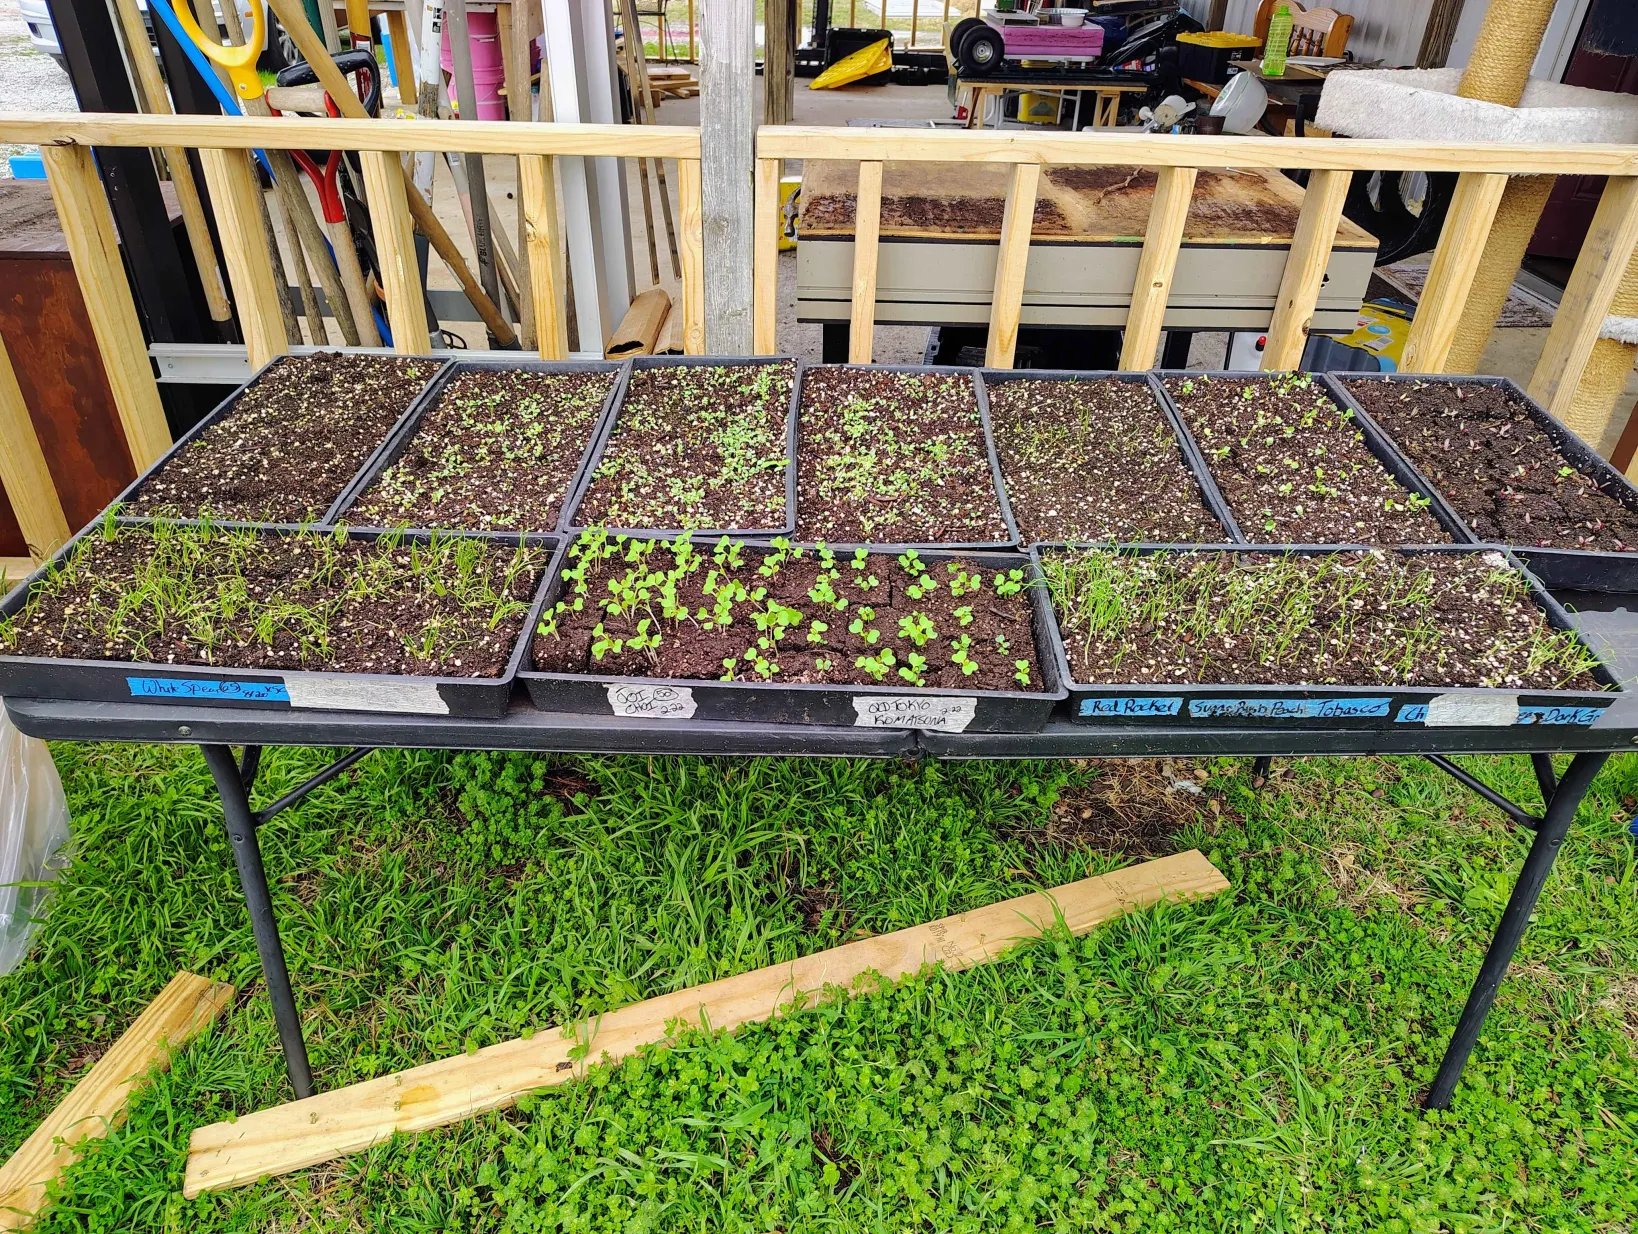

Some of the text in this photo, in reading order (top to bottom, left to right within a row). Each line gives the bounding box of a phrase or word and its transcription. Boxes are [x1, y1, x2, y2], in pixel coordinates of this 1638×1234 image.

[625, 698, 658, 714] CHOI
[868, 701, 890, 713] OLD
[891, 698, 931, 712] TOKYO
[1093, 700, 1120, 713] Red
